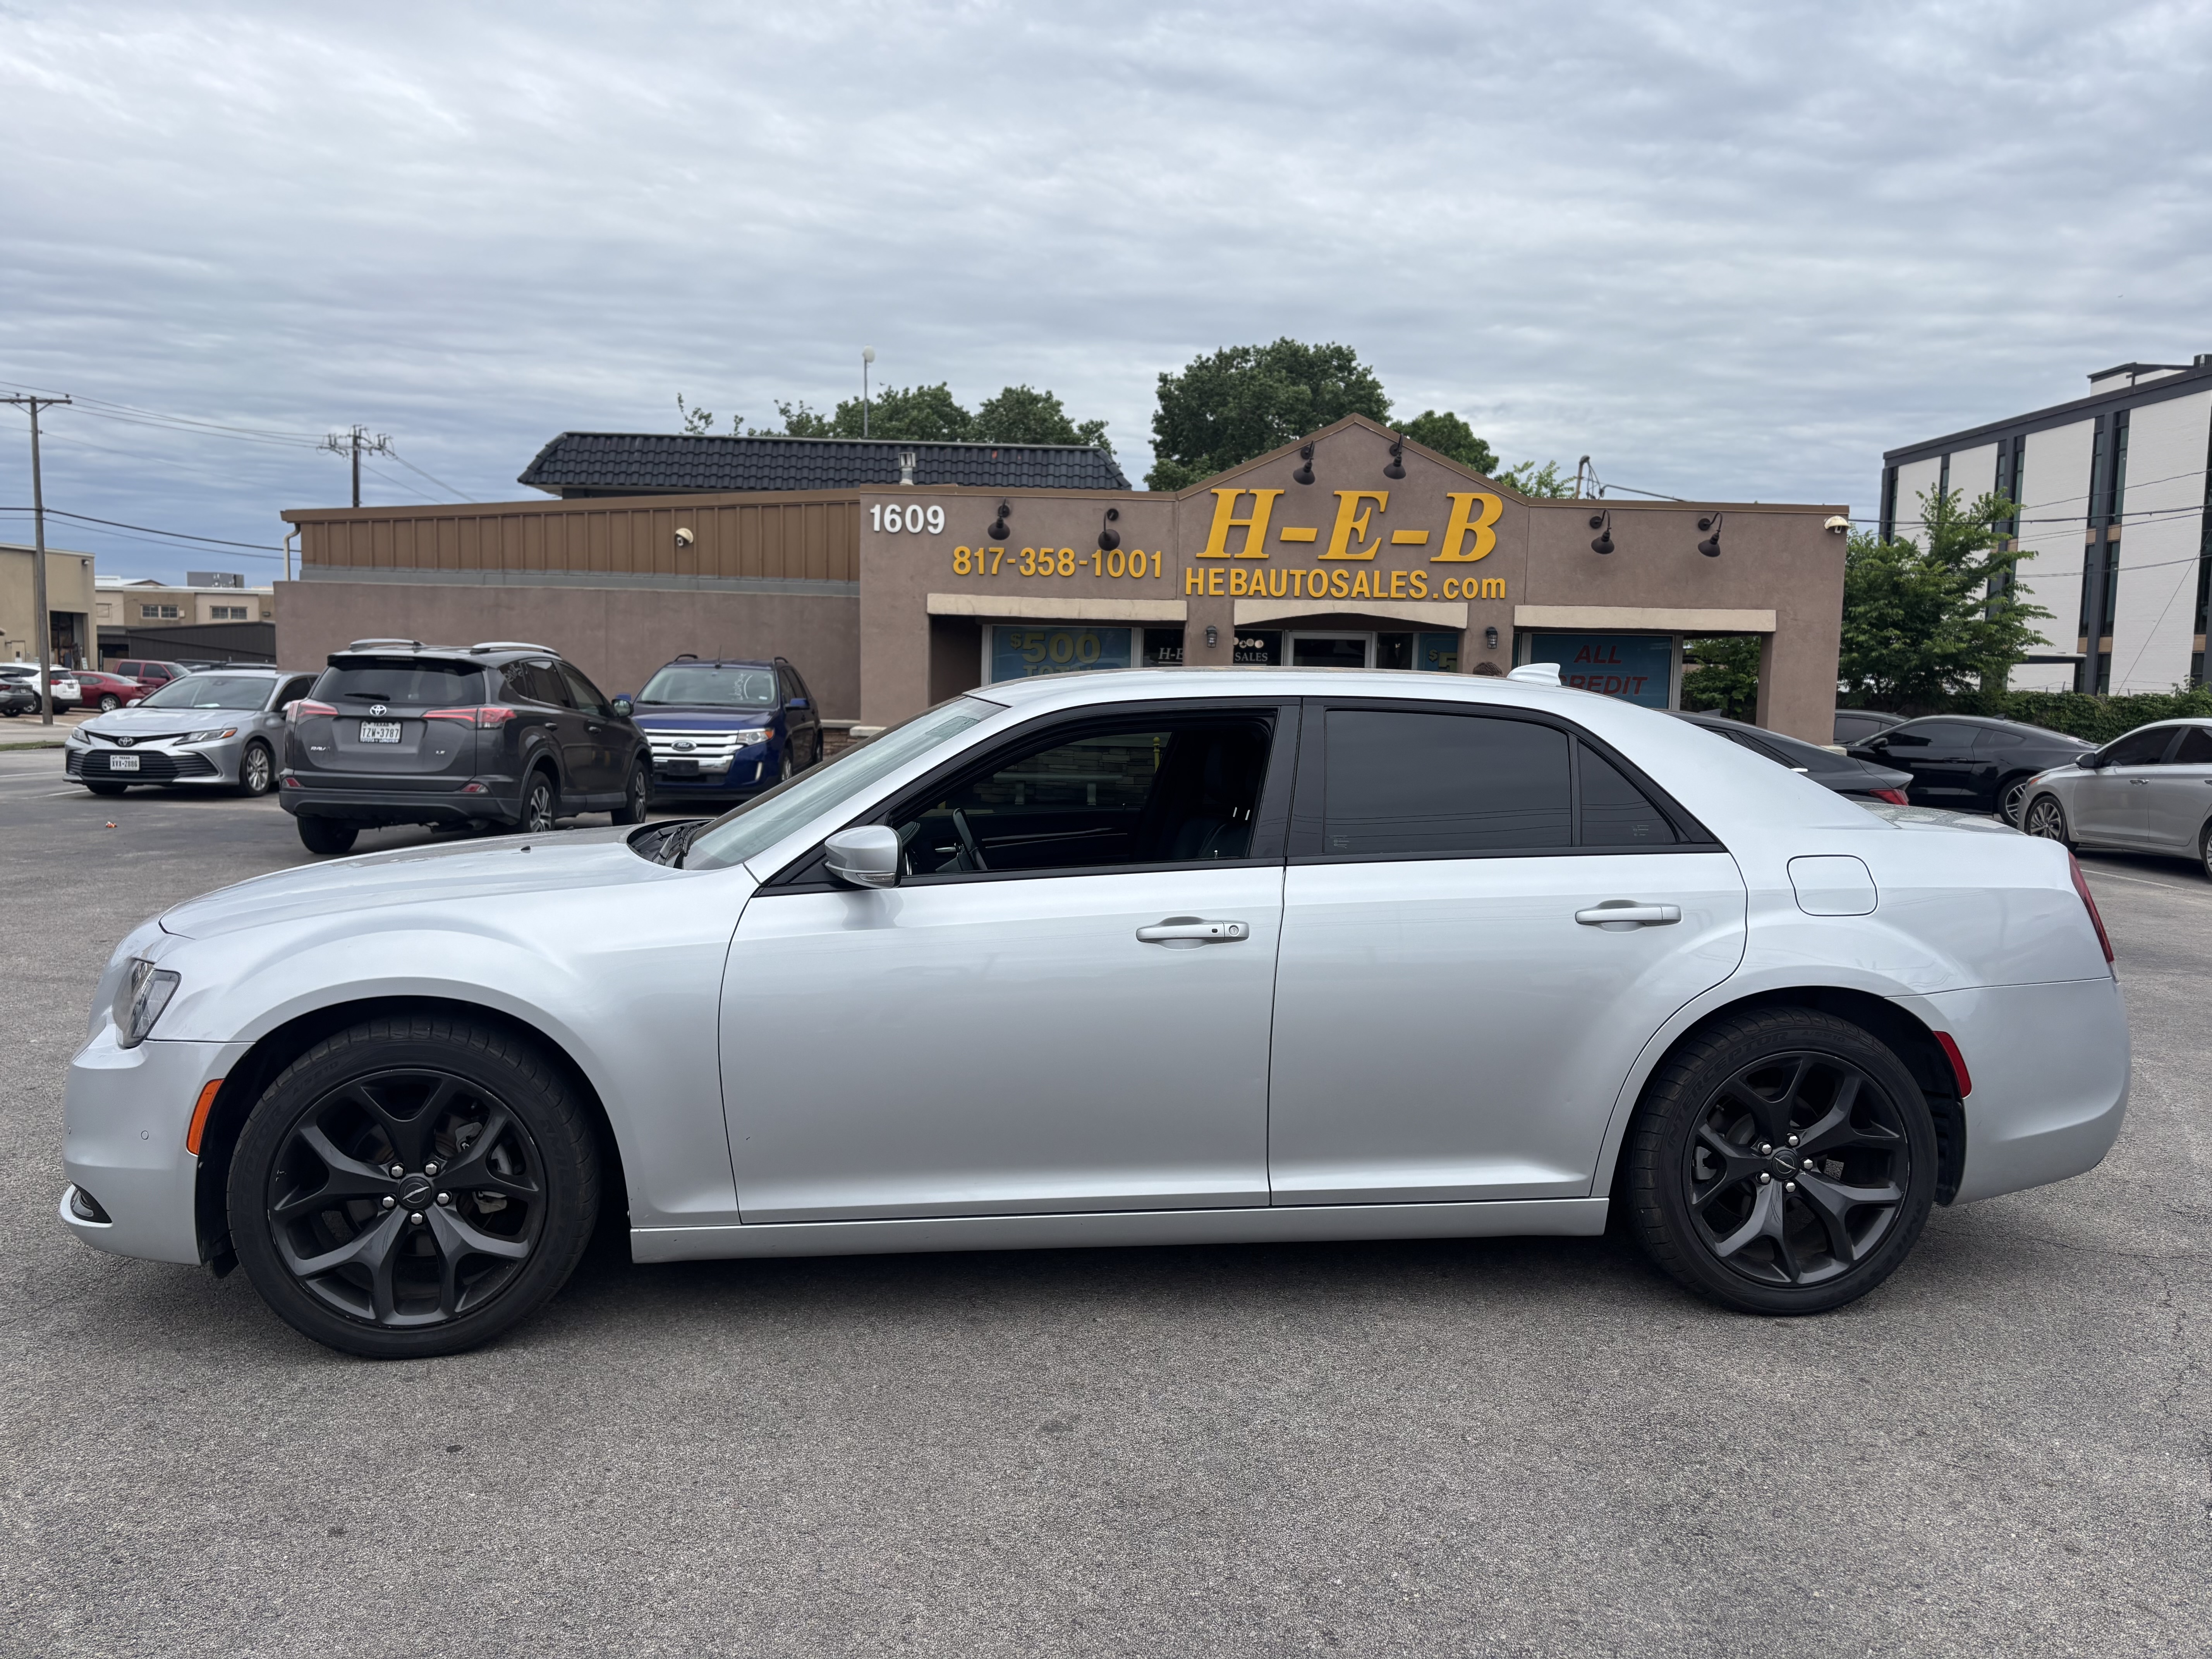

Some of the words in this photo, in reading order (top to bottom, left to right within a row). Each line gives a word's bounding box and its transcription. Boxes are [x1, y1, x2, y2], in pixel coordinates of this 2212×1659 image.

[870, 504, 945, 534] 1609
[1196, 488, 1503, 562] H-E-B
[953, 546, 1162, 578] 817-358-1001
[1185, 567, 1506, 599] HEBAUTOSALES.com
[1010, 632, 1101, 663] $500
[1235, 653, 1267, 661] SALES
[1573, 645, 1622, 664] ALL
[1666, 1031, 1788, 1151] INTERCEPTOR
